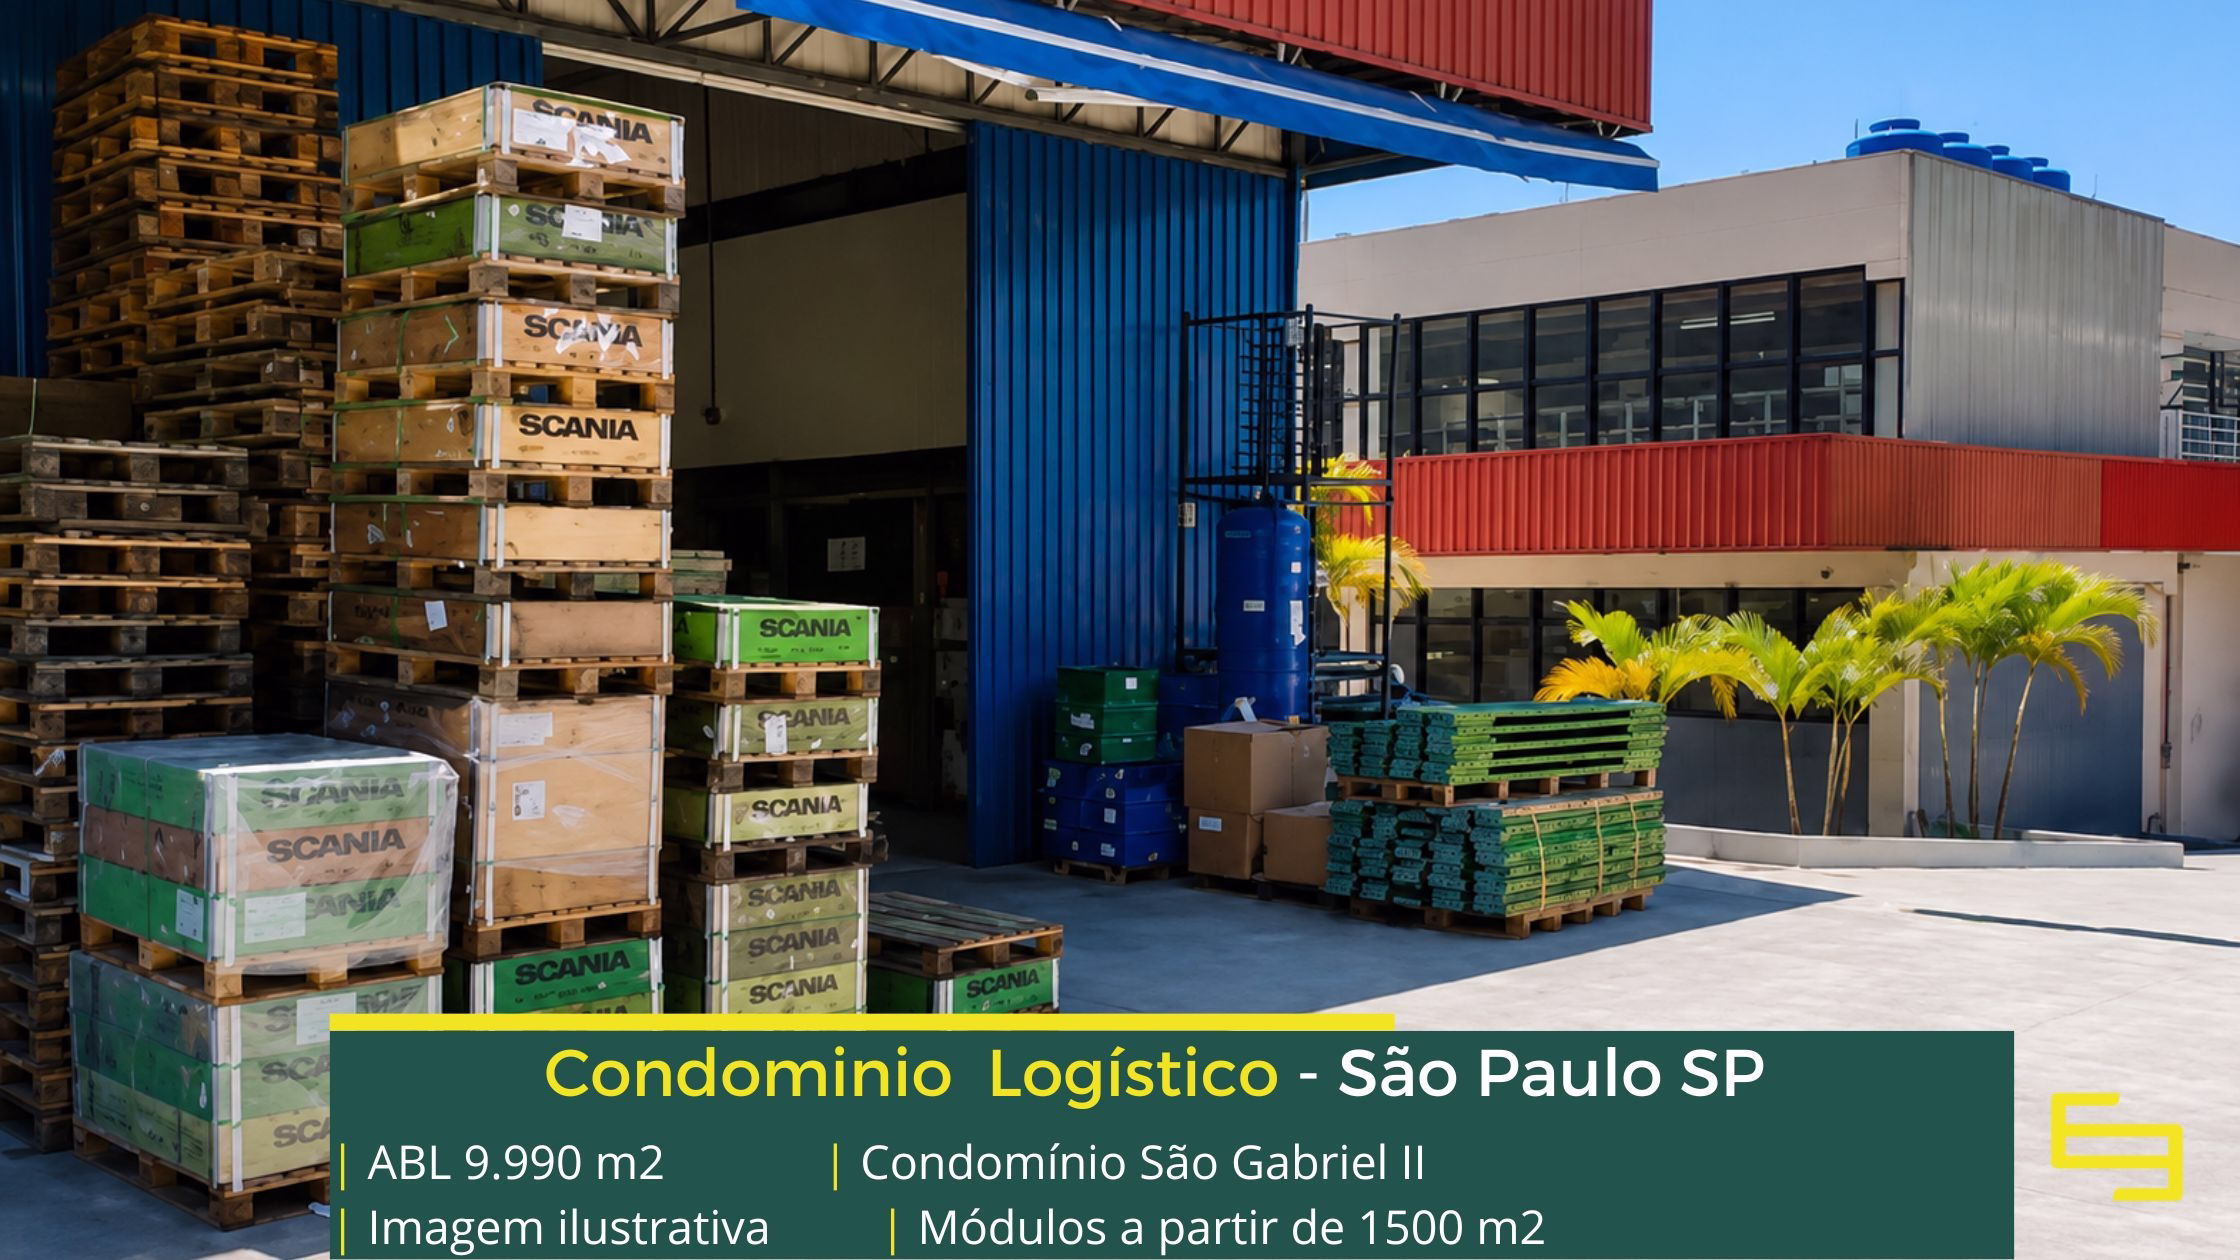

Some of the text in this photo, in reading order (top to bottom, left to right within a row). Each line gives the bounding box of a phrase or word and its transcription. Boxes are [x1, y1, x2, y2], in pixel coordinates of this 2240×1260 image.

[519, 413, 639, 441] SCANIA
[759, 618, 851, 637] SCANIA
[751, 795, 843, 819] SCANIA
[267, 828, 406, 863] SCANIA
[748, 879, 841, 907] SCANIA
[748, 927, 841, 957] SCANIA
[515, 950, 631, 986] SCANIA
[966, 968, 1040, 998] SCANIA
[749, 974, 838, 1004] SCANIA
